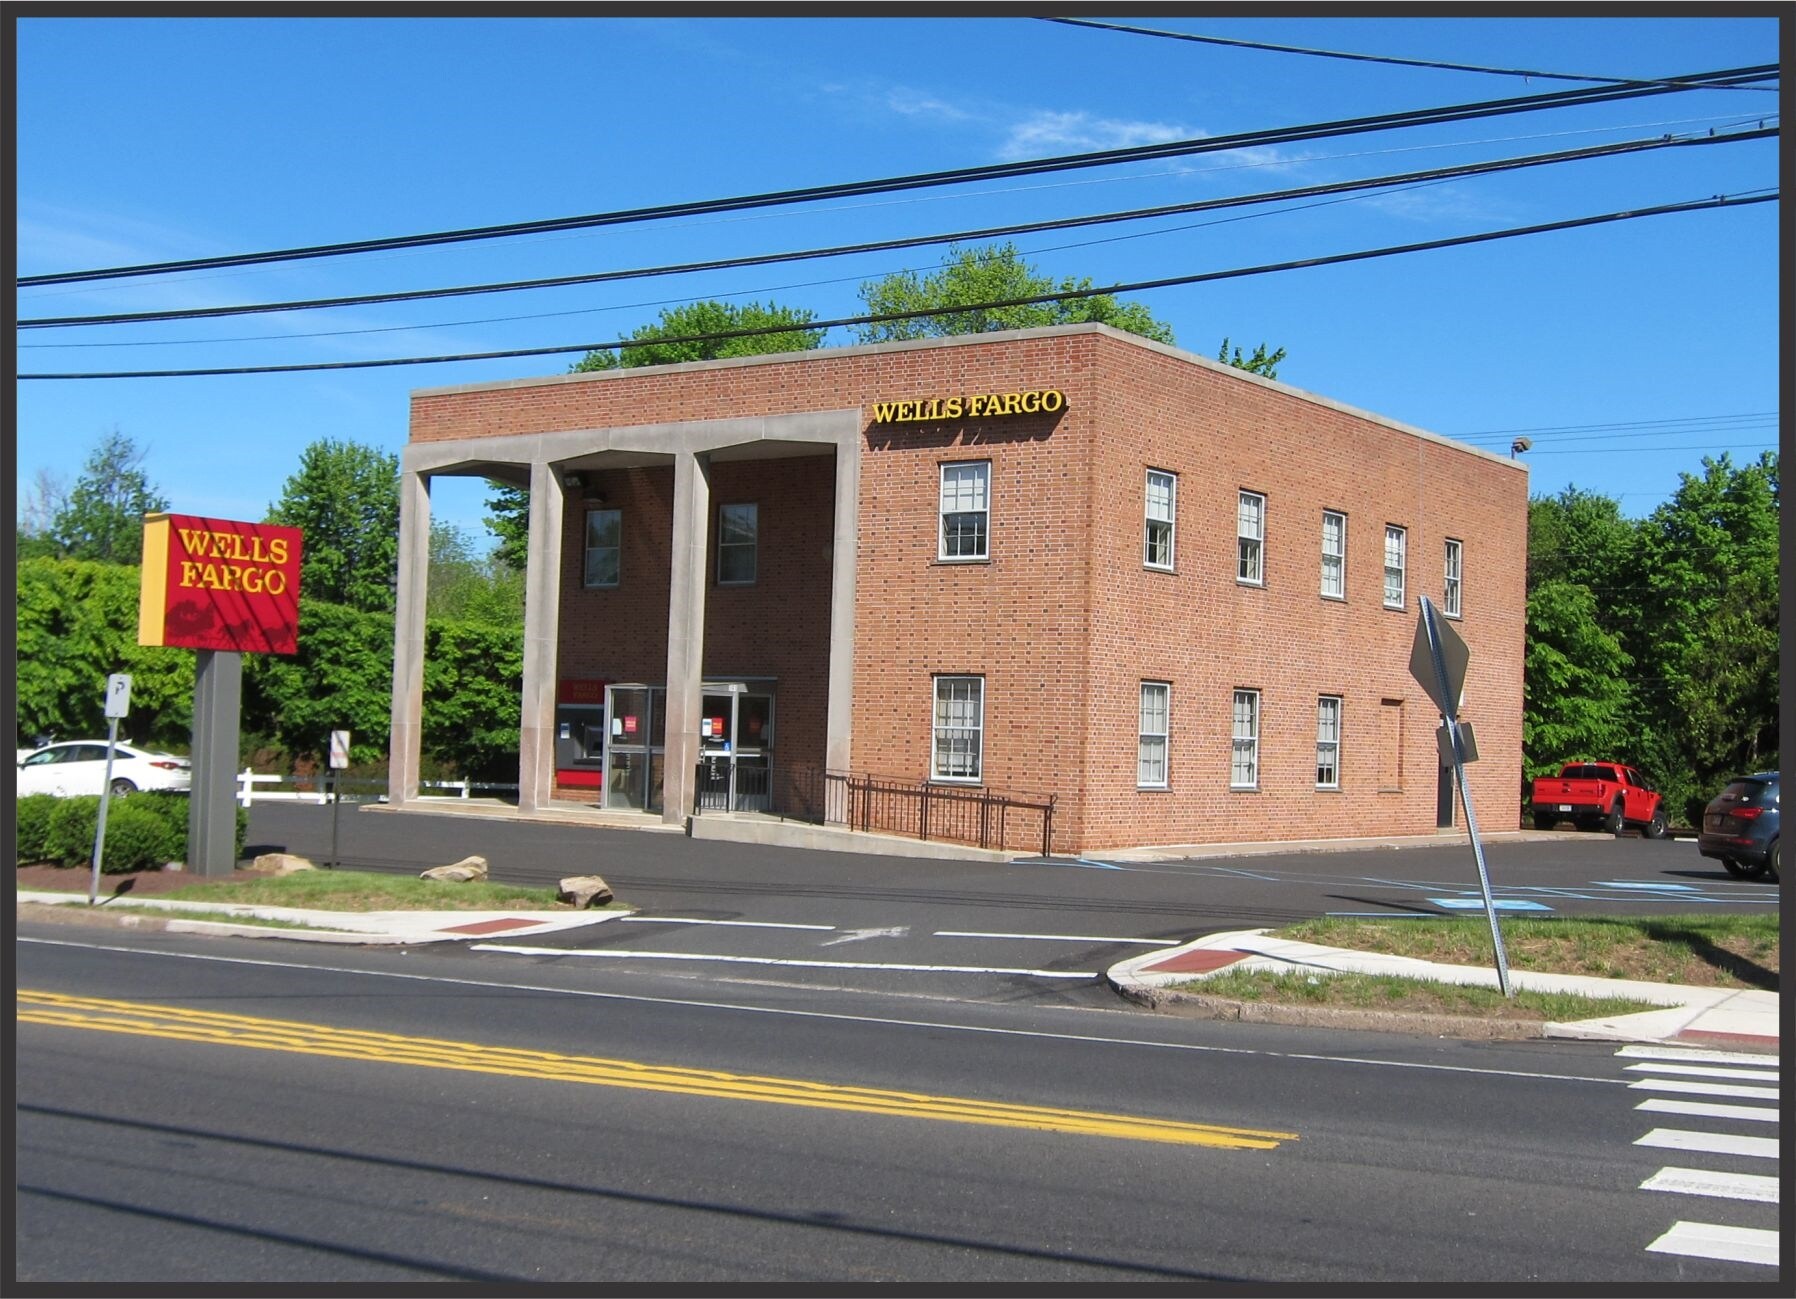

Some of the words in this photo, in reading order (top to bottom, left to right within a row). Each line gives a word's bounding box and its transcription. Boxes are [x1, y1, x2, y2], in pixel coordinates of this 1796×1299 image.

[872, 397, 963, 424] WELLS
[968, 390, 1063, 417] FARGO
[178, 528, 288, 564] WELLS
[179, 561, 286, 595] FARGO
